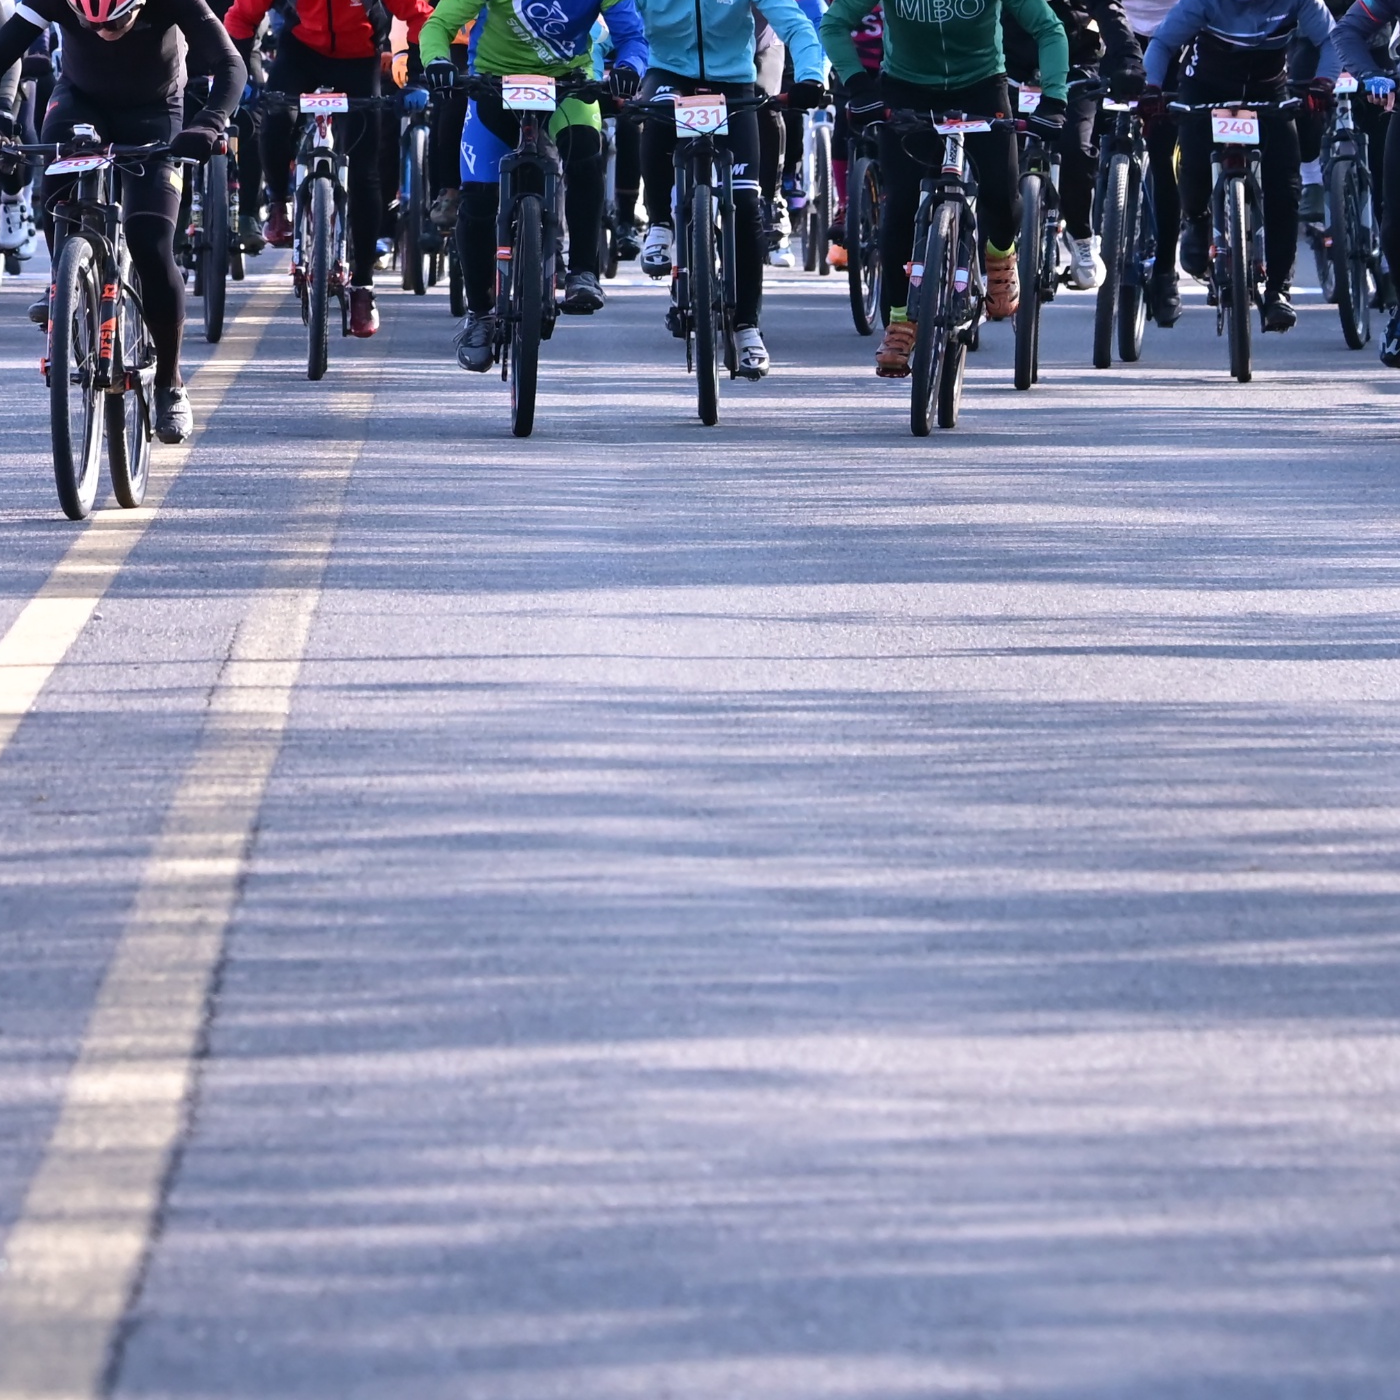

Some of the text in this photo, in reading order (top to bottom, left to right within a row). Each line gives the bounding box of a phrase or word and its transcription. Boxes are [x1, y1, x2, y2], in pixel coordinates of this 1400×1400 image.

[508, 87, 551, 102] 253
[305, 98, 343, 108] 205
[682, 108, 722, 127] 231
[1217, 120, 1254, 135] 240
